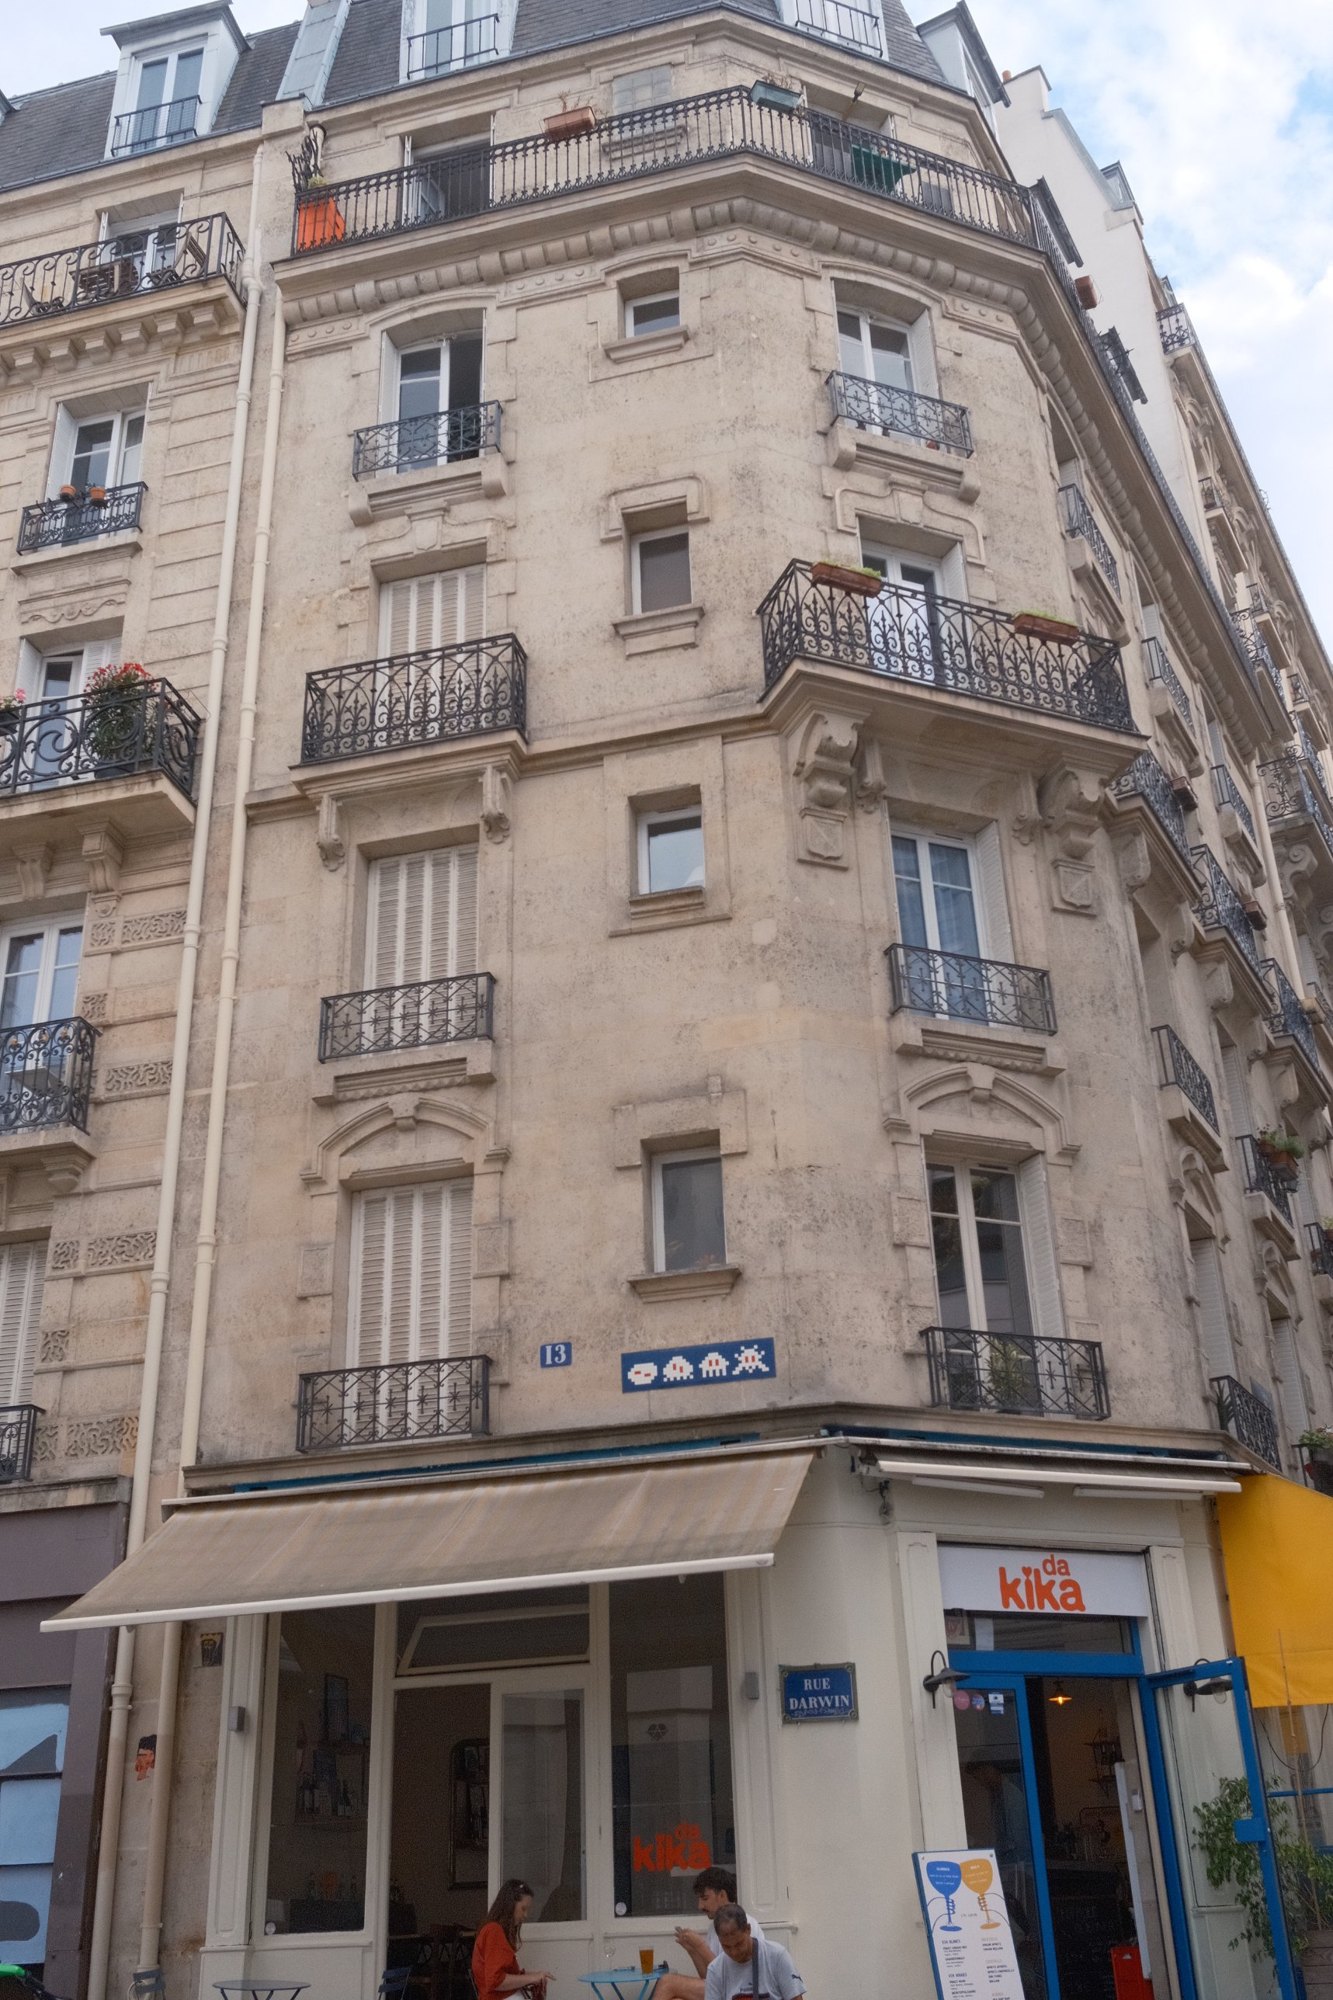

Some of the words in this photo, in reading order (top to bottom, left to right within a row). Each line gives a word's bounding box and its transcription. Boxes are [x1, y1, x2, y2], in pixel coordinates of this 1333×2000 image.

[545, 1344, 567, 1365] 13
[1042, 1553, 1071, 1577] da
[998, 1566, 1086, 1612] kika
[803, 1677, 831, 1691] RUE
[789, 1695, 850, 1710] DARWIN
[632, 1832, 713, 1872] kika
